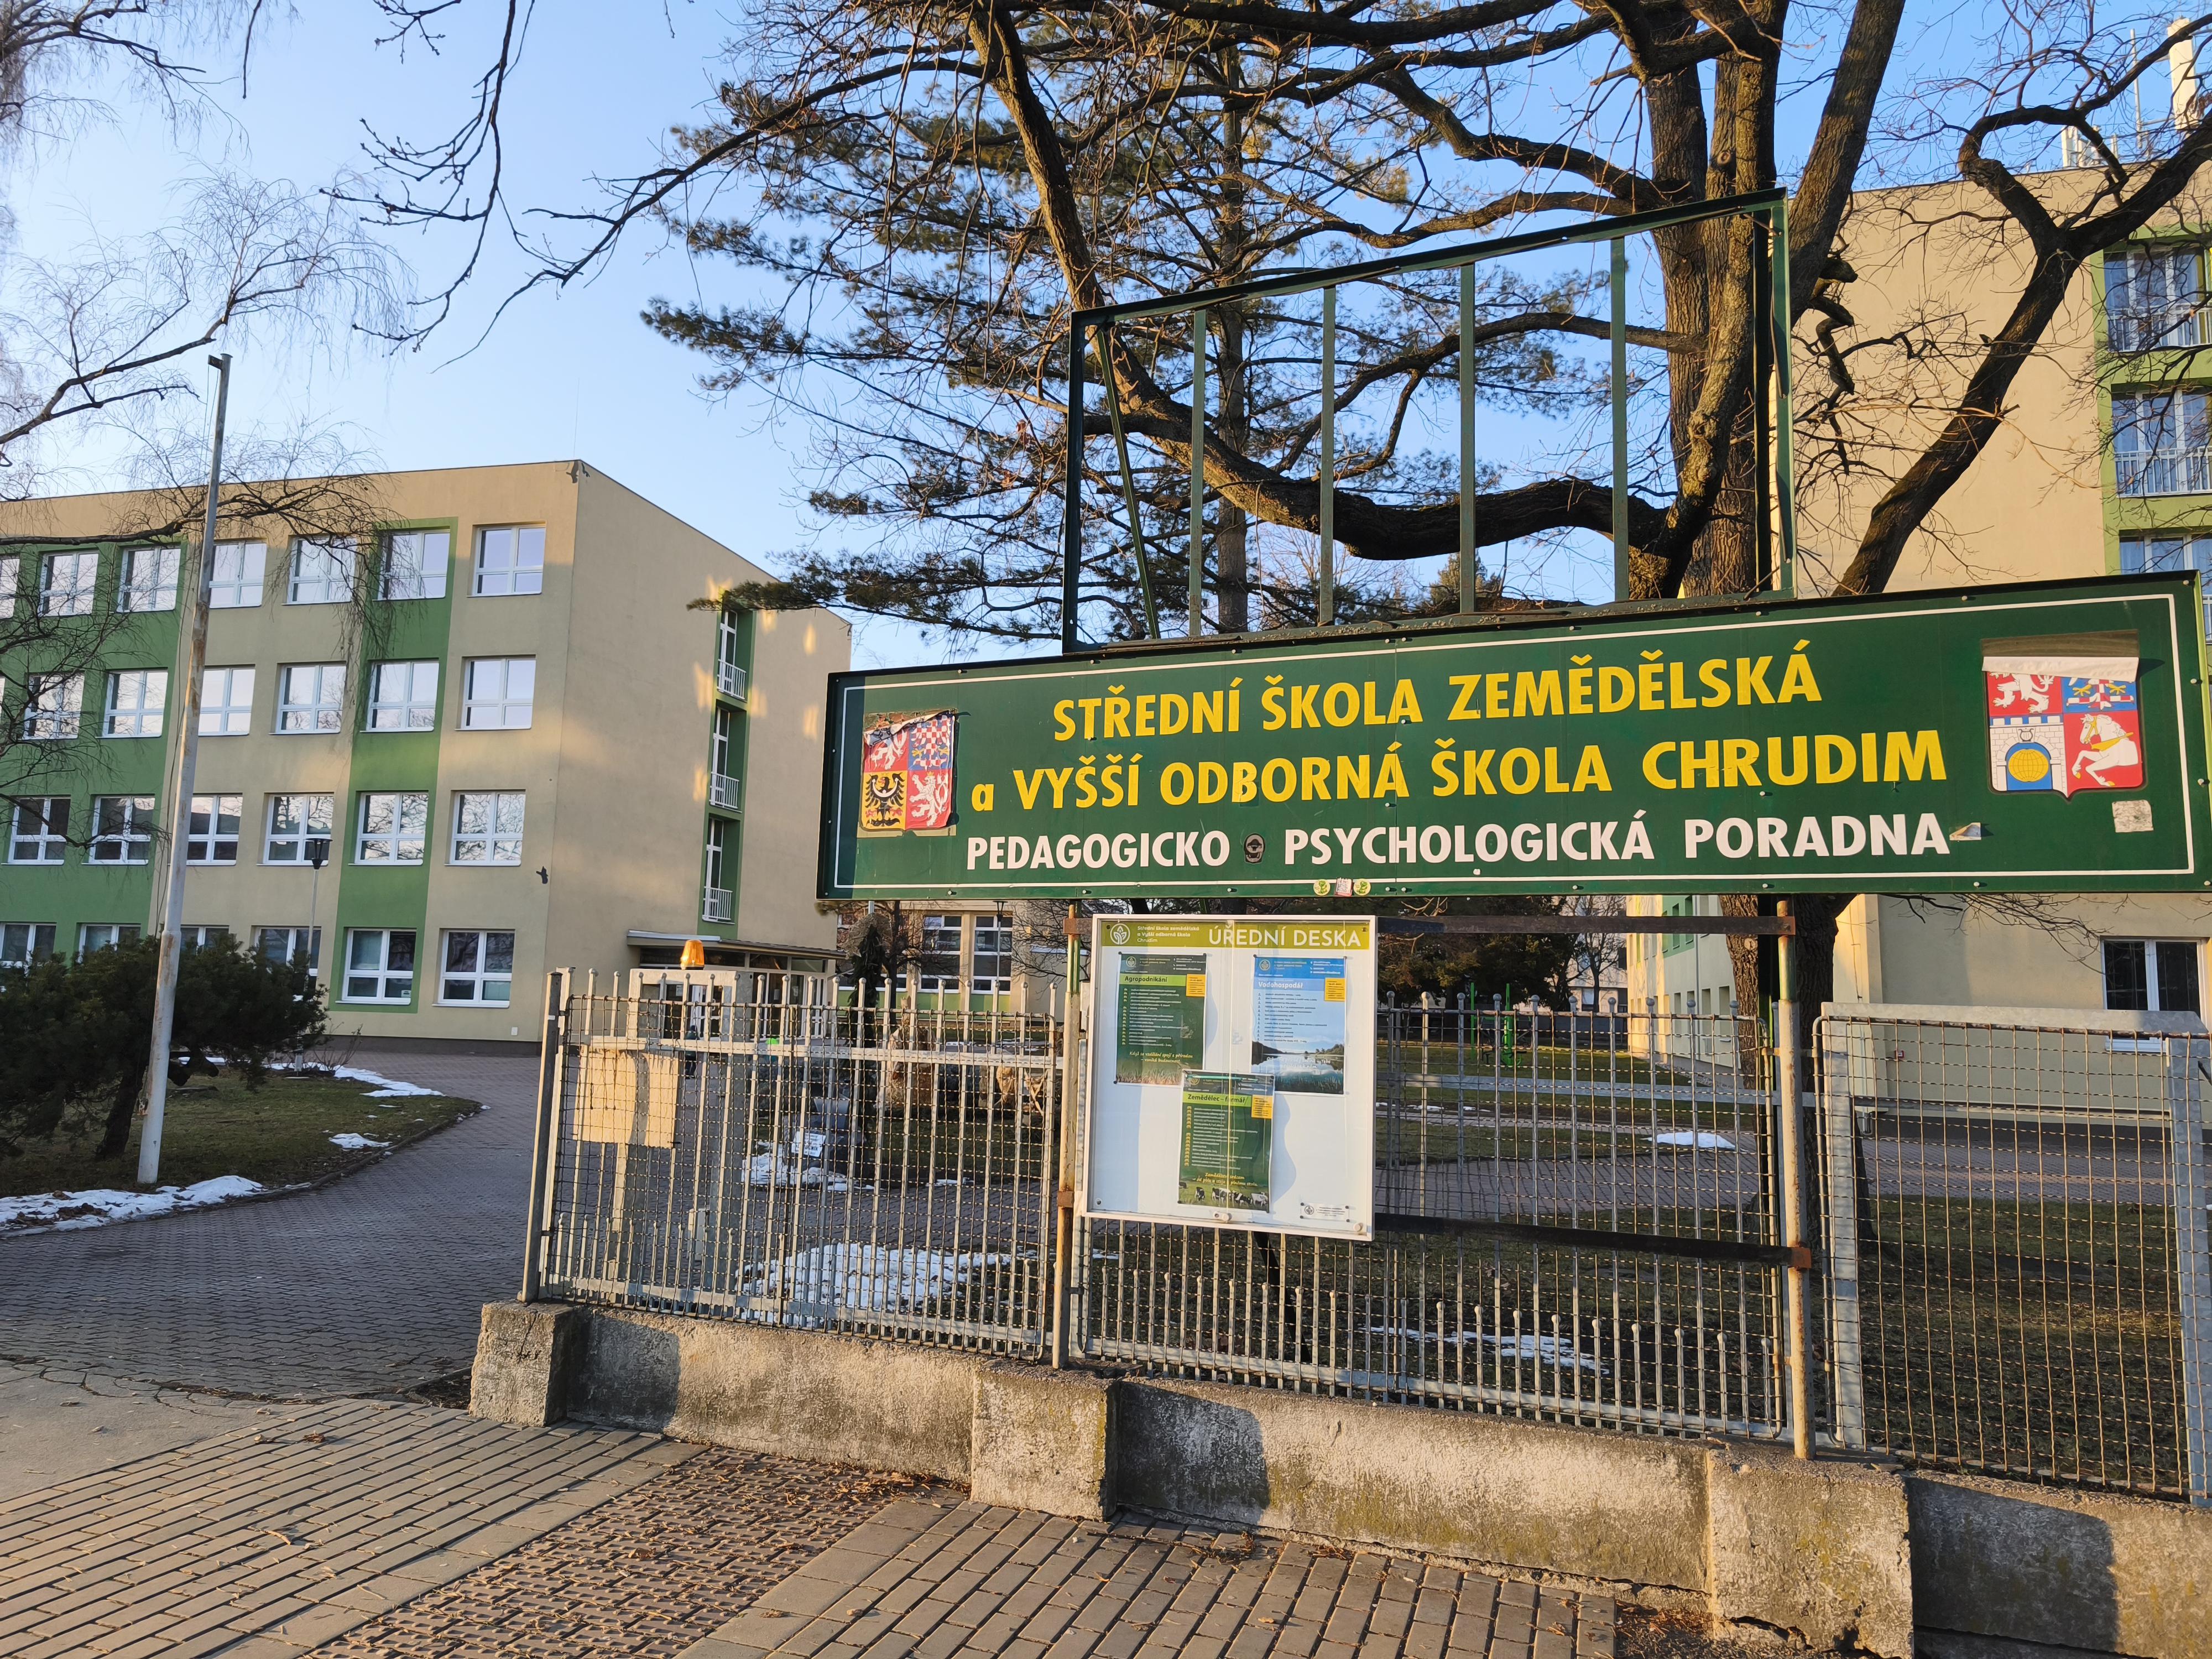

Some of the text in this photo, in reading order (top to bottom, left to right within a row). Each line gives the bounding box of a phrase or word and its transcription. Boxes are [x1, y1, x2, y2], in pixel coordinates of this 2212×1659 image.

[1054, 639, 1822, 740] STŘEDNÍ ŠKOLA ZEMĚDĚLSKÁ
[972, 731, 1946, 811] a VYŠŠÍ ODBORNÁ ŠKOLA CHRUDIM
[967, 810, 1949, 869] PEDAGOGICKO PSYCHOLOGICKÁ PORADNA
[1209, 925, 1361, 947] ÚŘEDNÍ DESKA
[1258, 981, 1304, 989] Vodohospodář
